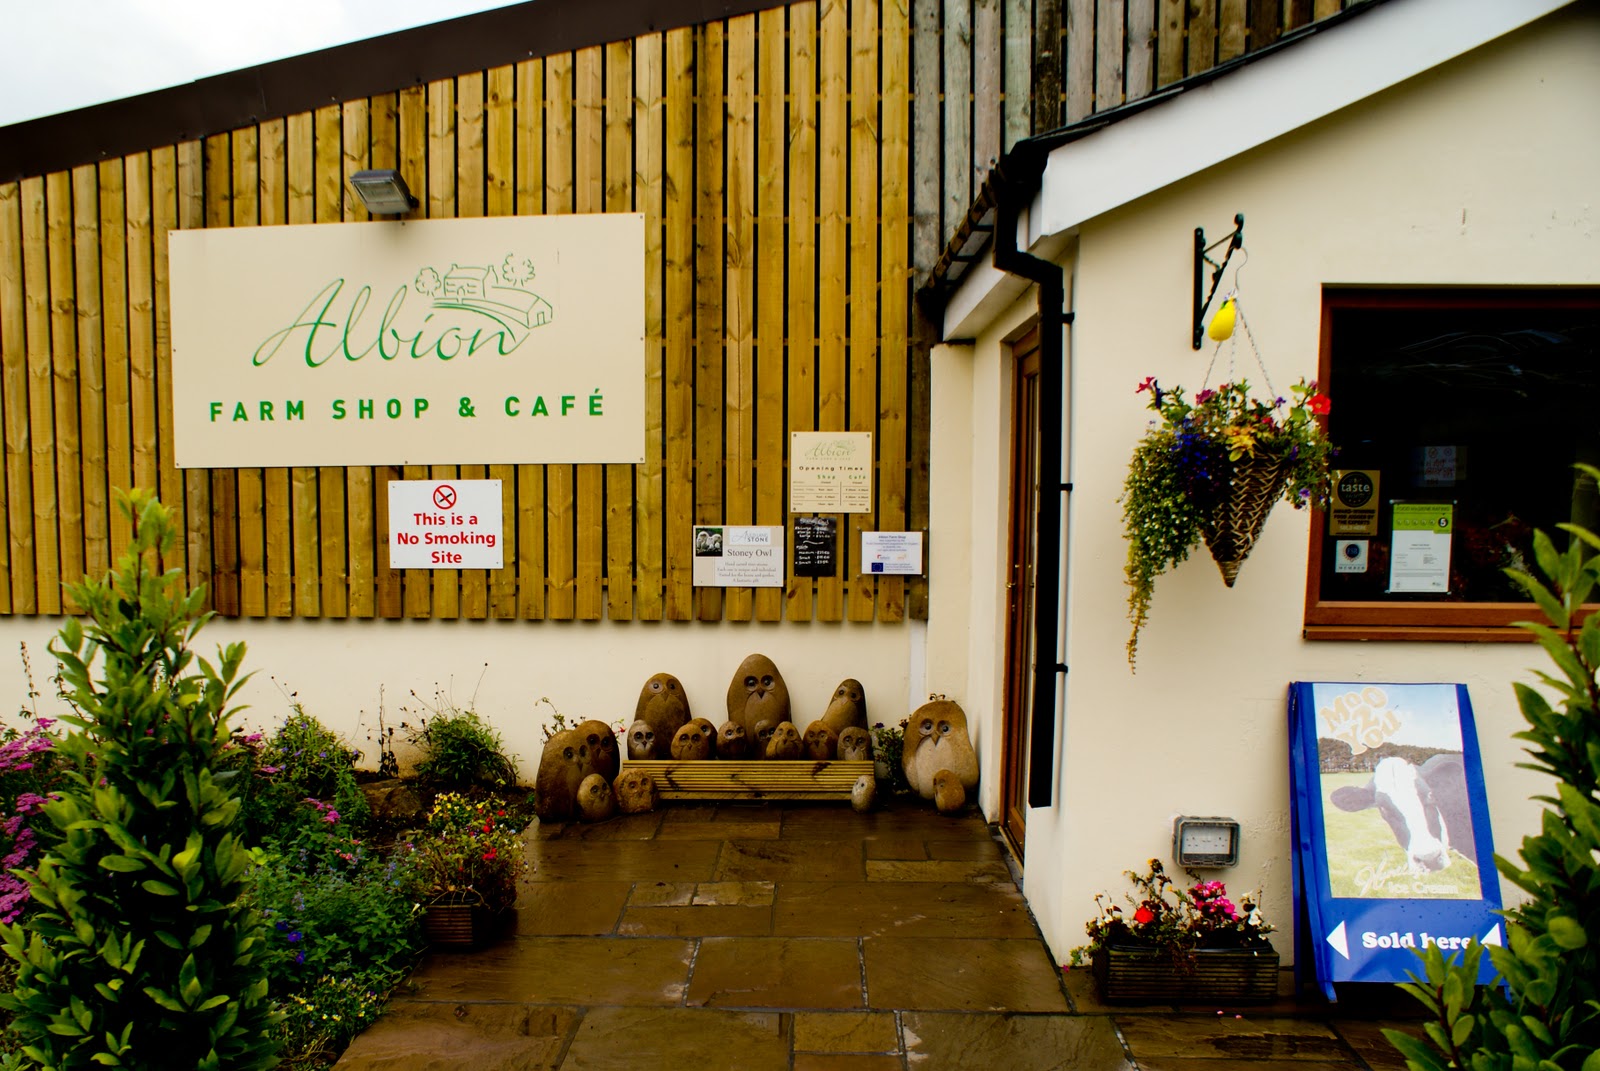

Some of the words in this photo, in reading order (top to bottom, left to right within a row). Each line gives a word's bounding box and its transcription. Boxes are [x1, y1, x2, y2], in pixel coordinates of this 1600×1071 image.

[252, 278, 530, 368] Albion
[209, 399, 305, 423] FARM
[332, 398, 430, 420] SHOP
[458, 396, 476, 418] &
[504, 388, 604, 417] CAFÉ
[804, 440, 853, 457] Albion
[1341, 483, 1370, 493] taste
[413, 512, 446, 526] This
[451, 512, 464, 526] is
[468, 515, 478, 525] a
[1440, 518, 1447, 527] 5
[397, 532, 420, 545] No
[424, 531, 496, 548] Smoking
[431, 550, 463, 564] Site
[727, 548, 754, 558] Stoney
[755, 548, 772, 557] Owl
[1387, 881, 1410, 894] Ice
[1411, 881, 1459, 895] Cream
[1361, 931, 1416, 949] Sold
[1419, 932, 1471, 950] here
